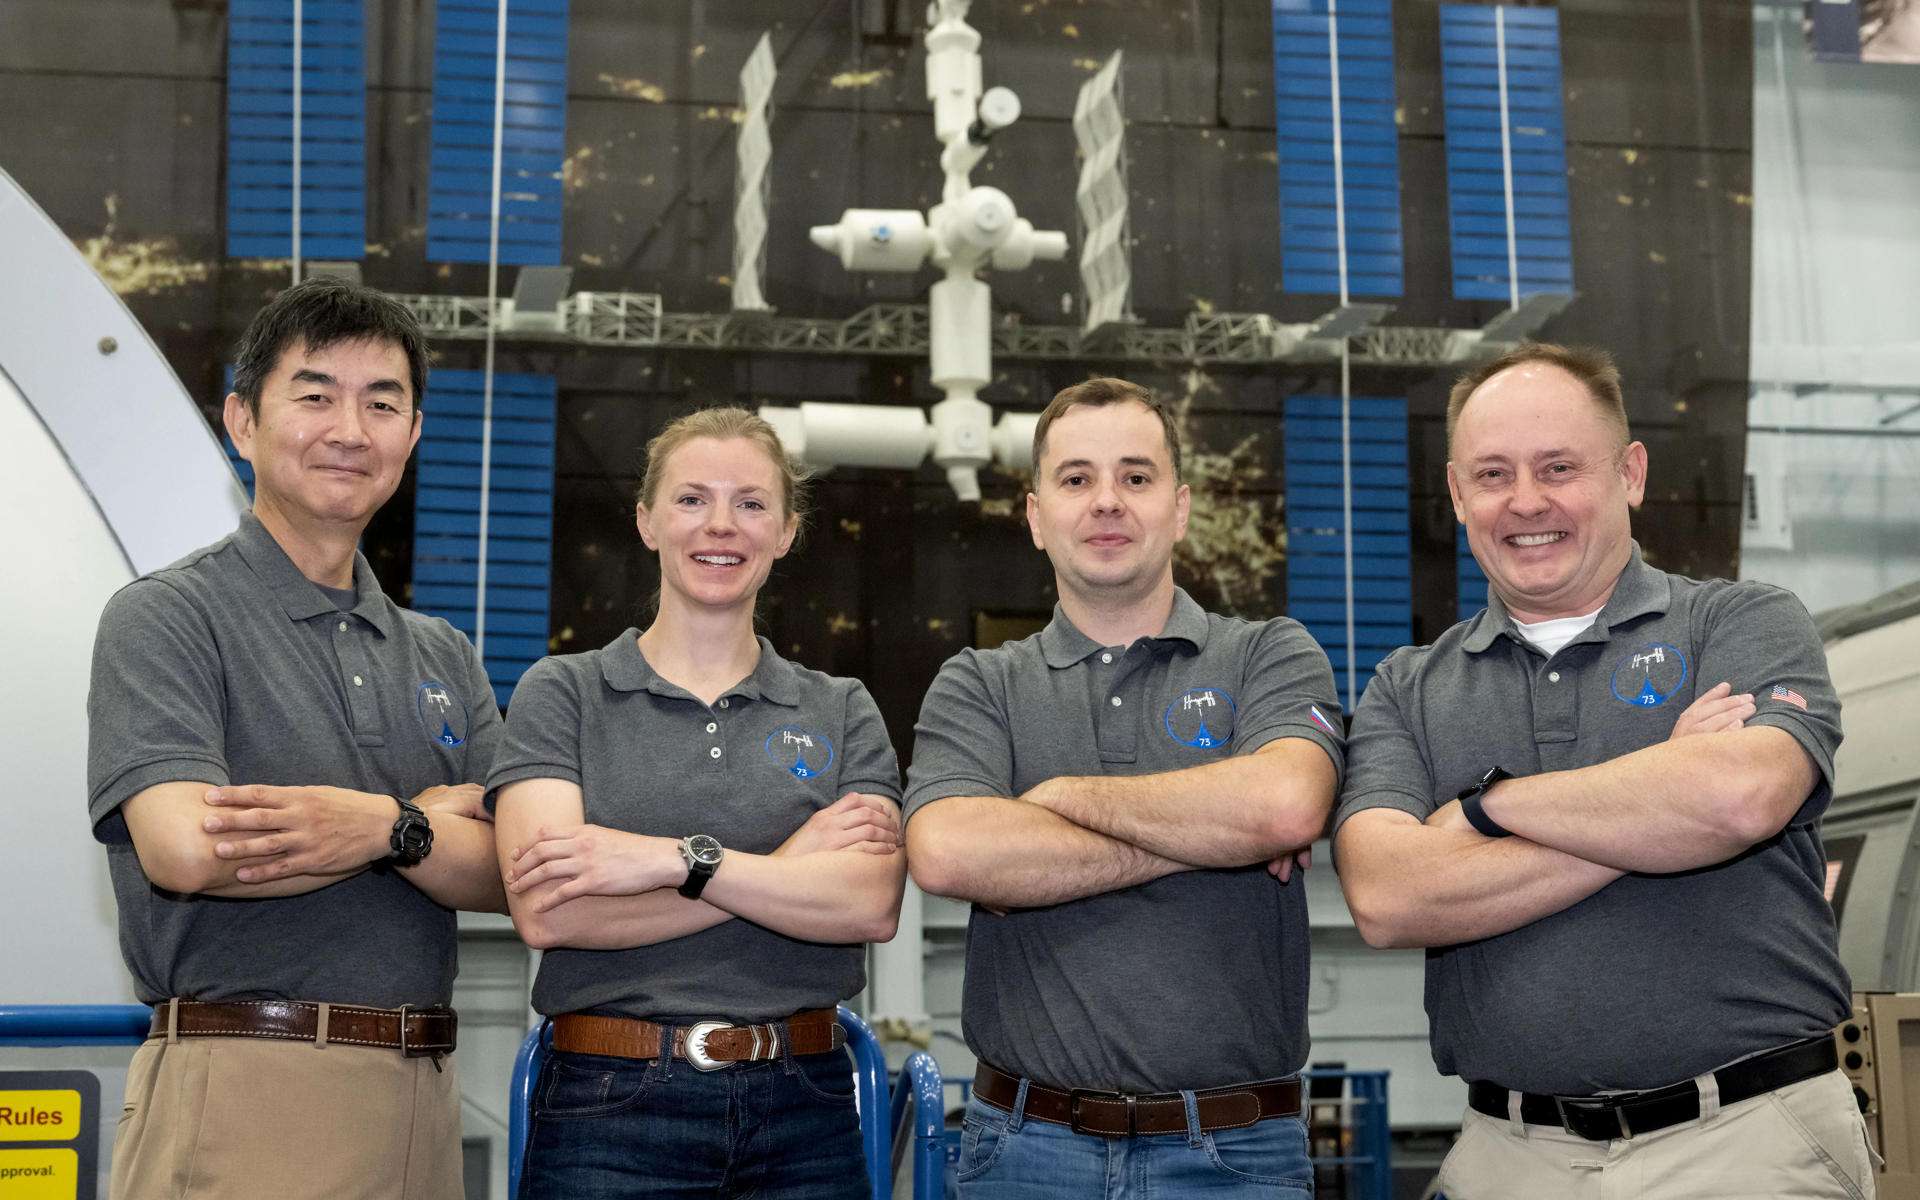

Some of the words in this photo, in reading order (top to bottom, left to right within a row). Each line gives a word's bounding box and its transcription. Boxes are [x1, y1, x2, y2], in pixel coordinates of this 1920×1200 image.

[1642, 694, 1656, 704] 73
[444, 735, 453, 744] 73
[1199, 737, 1211, 746] 73
[797, 768, 808, 777] 73
[0, 1106, 63, 1125] Rules
[0, 1165, 56, 1180] pproval.
